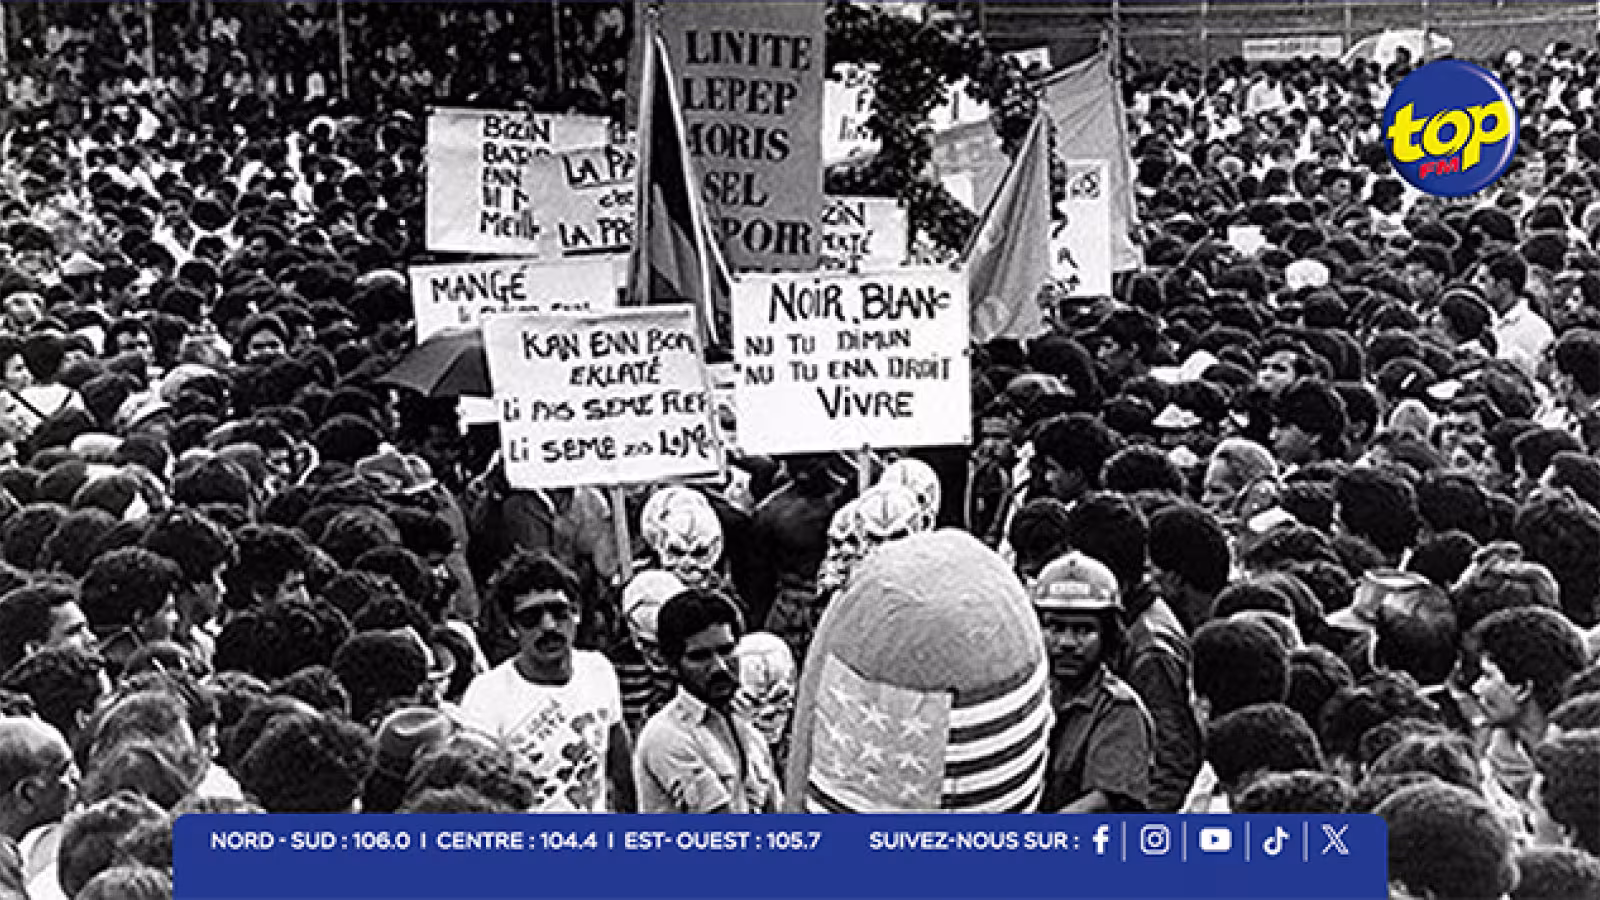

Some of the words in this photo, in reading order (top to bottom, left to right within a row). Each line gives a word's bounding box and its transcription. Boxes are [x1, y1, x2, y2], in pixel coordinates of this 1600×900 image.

[685, 30, 812, 71] LINITE
[682, 77, 798, 115] LEPEP
[562, 155, 600, 185] LA
[559, 221, 592, 247] LA
[430, 264, 529, 304] MANGÉ
[520, 330, 580, 361] KAN
[589, 330, 639, 358] ENN
[744, 335, 774, 357] NU
[786, 332, 816, 354] TU
[569, 355, 662, 387] EKLATÉ
[744, 364, 775, 385] NU
[788, 360, 818, 382] TU
[827, 357, 879, 380] ENA
